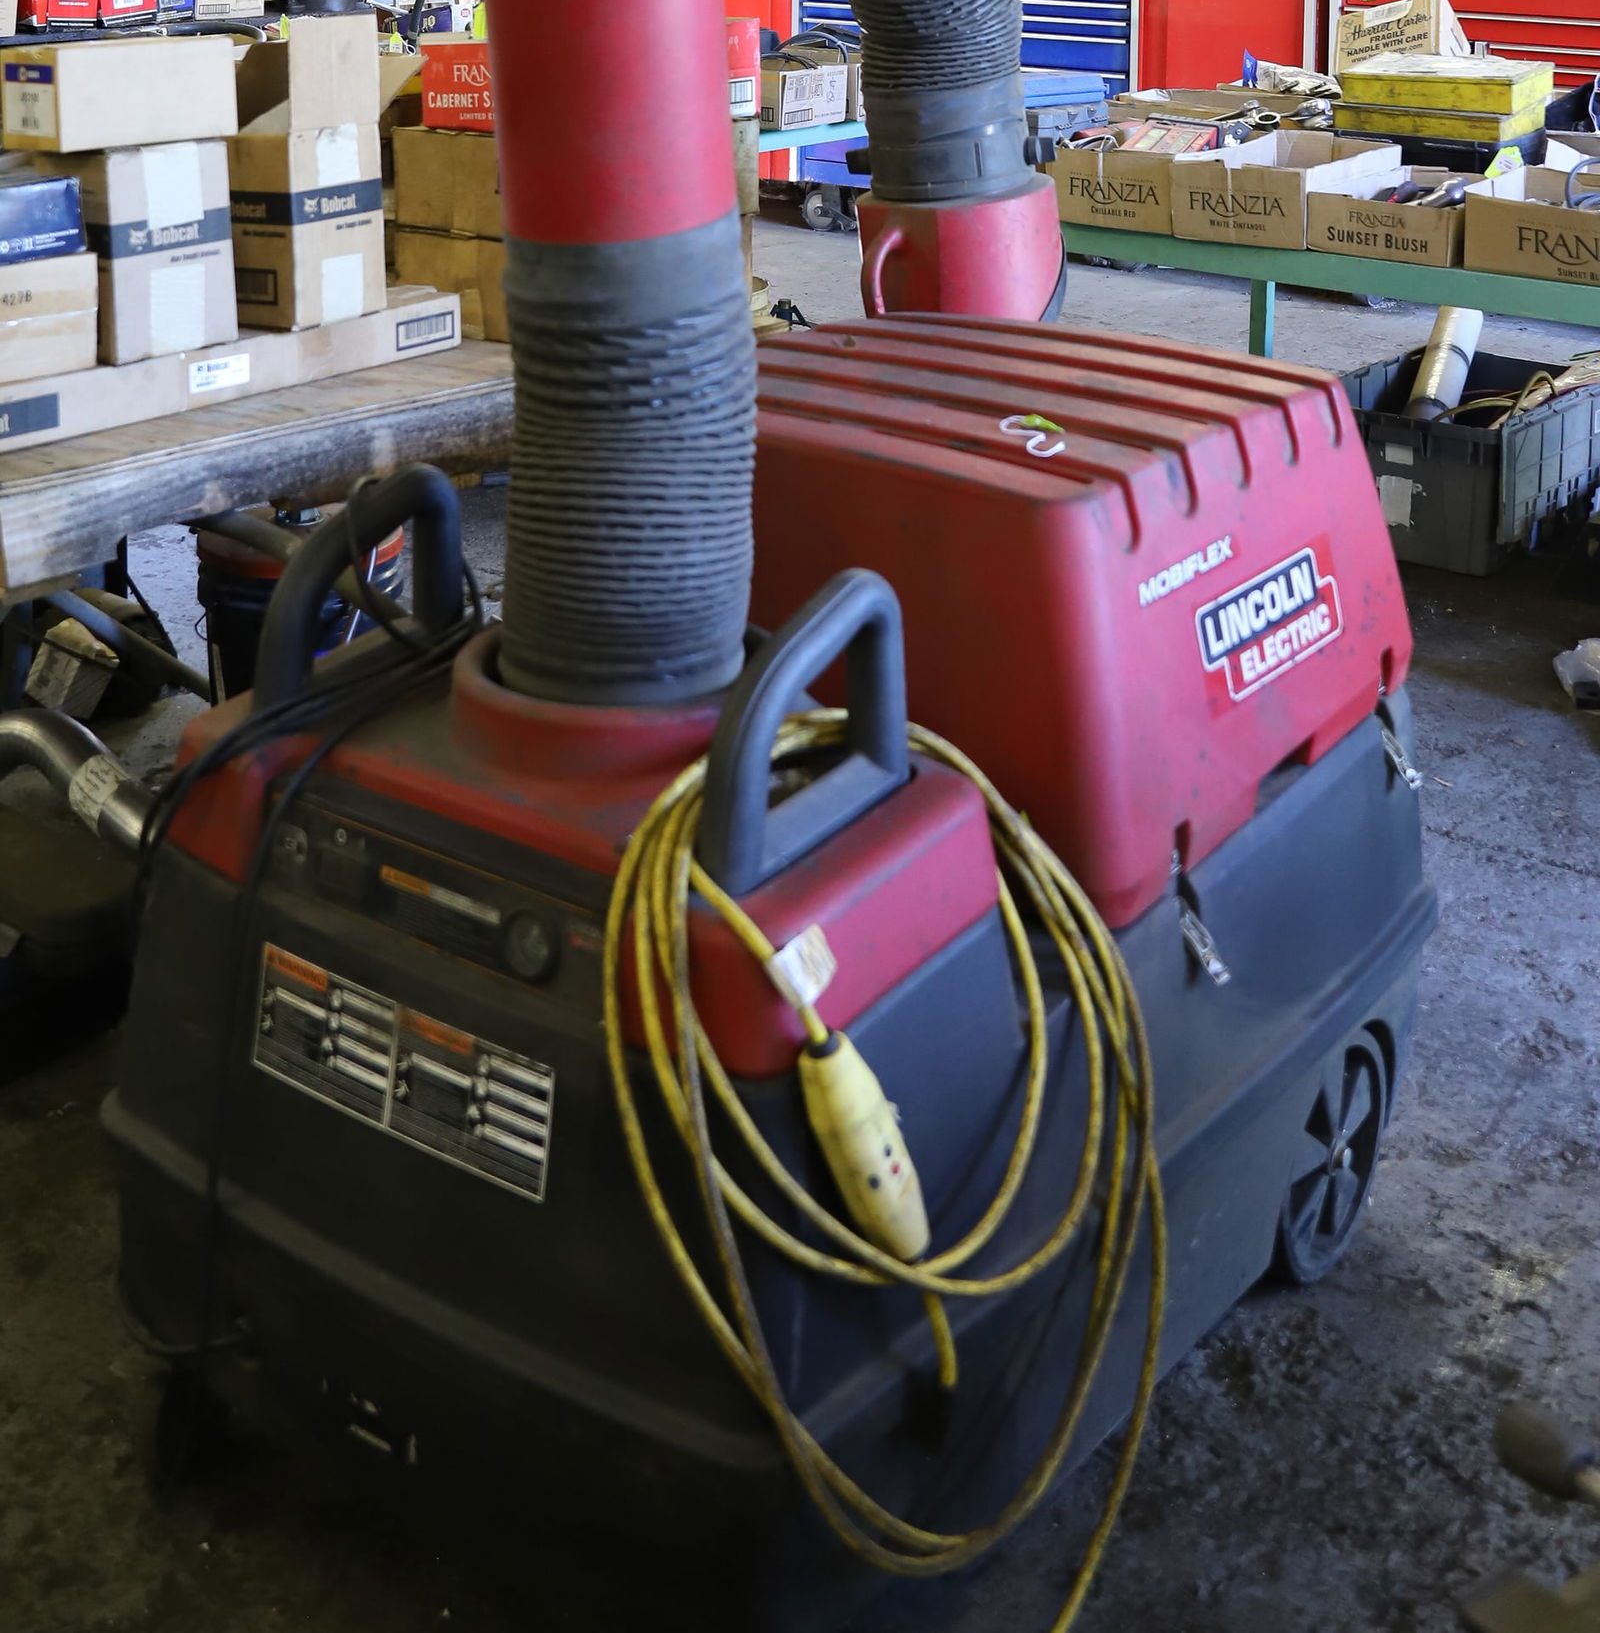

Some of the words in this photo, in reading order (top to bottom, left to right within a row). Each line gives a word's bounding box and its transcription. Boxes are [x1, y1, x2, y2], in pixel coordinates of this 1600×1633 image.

[1346, 43, 1381, 57] HANDLE
[1382, 37, 1404, 49] WITH
[1405, 31, 1429, 44] CARE
[1369, 29, 1405, 43] FRAGILE
[428, 91, 480, 108] CABERNET
[482, 90, 495, 108] S
[320, 193, 357, 215] Bobcat
[1069, 176, 1160, 206] FRANZIA
[1189, 191, 1286, 219] FRANZIA
[1348, 210, 1406, 230] FRANZIA
[151, 223, 200, 247] Bobcat
[1327, 225, 1379, 247] SUNSET
[1384, 233, 1428, 254] BLUSH
[1138, 534, 1234, 608] MOBIFLEX
[1203, 561, 1316, 658] LINCOLN
[1239, 603, 1332, 683] ELECTRIC
